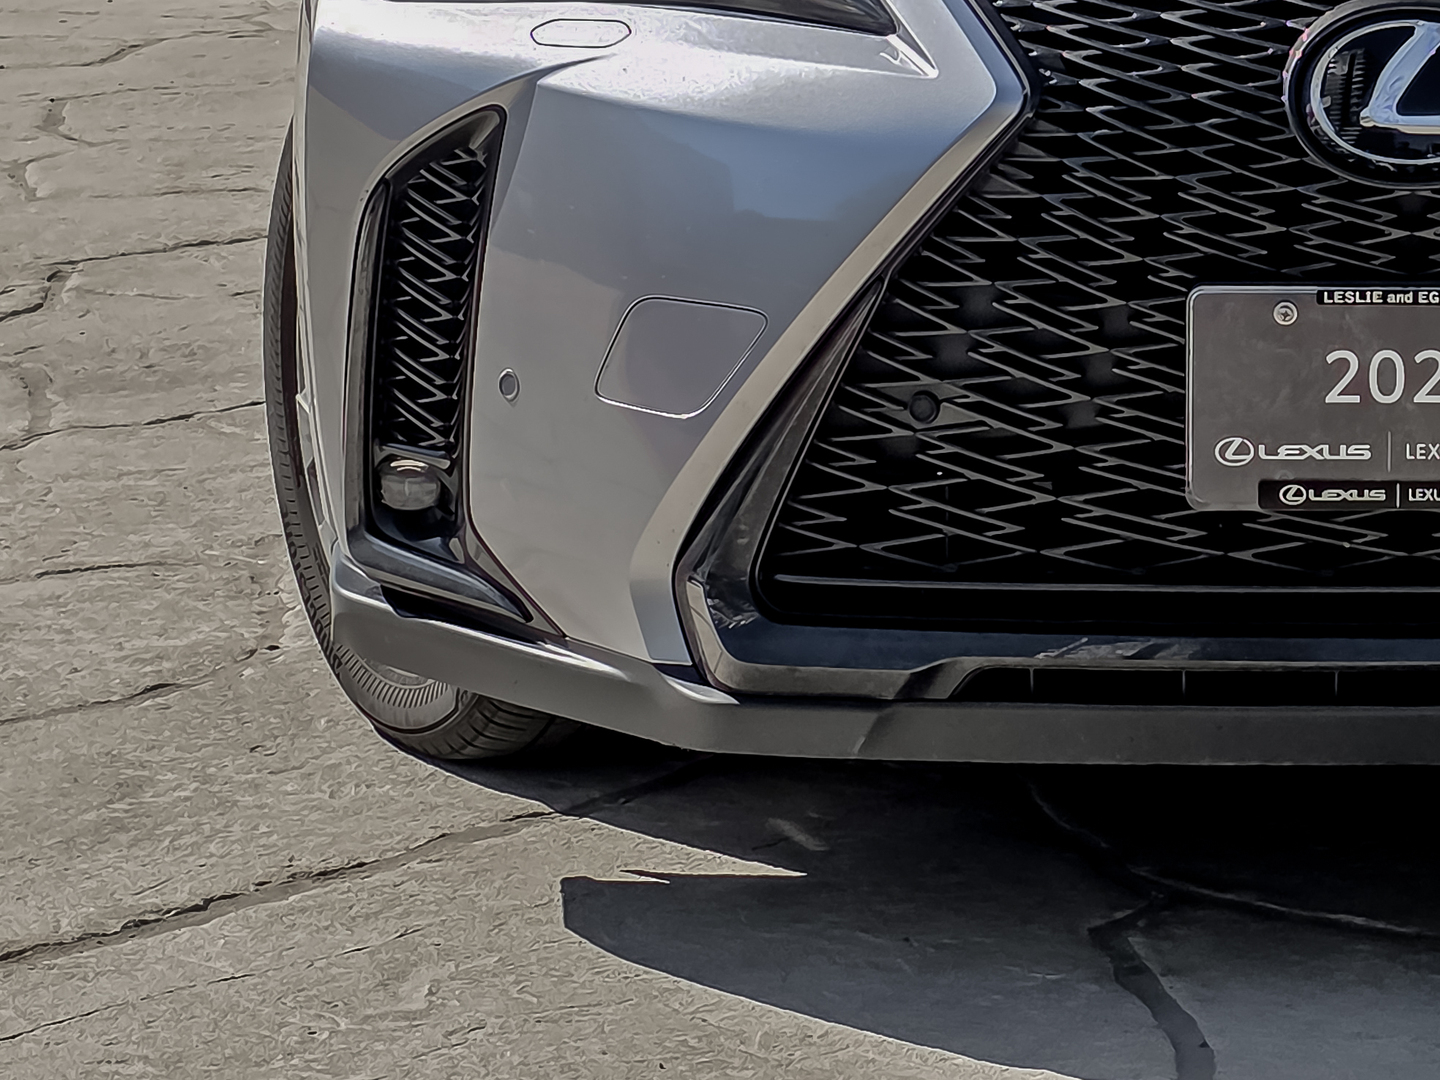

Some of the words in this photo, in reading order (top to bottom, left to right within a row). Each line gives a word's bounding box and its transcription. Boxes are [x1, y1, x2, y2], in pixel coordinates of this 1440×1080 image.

[1323, 290, 1384, 304] LESLIE
[1386, 290, 1414, 304] and
[1258, 444, 1372, 460] LEXUS
[1308, 488, 1387, 502] LEXUS
